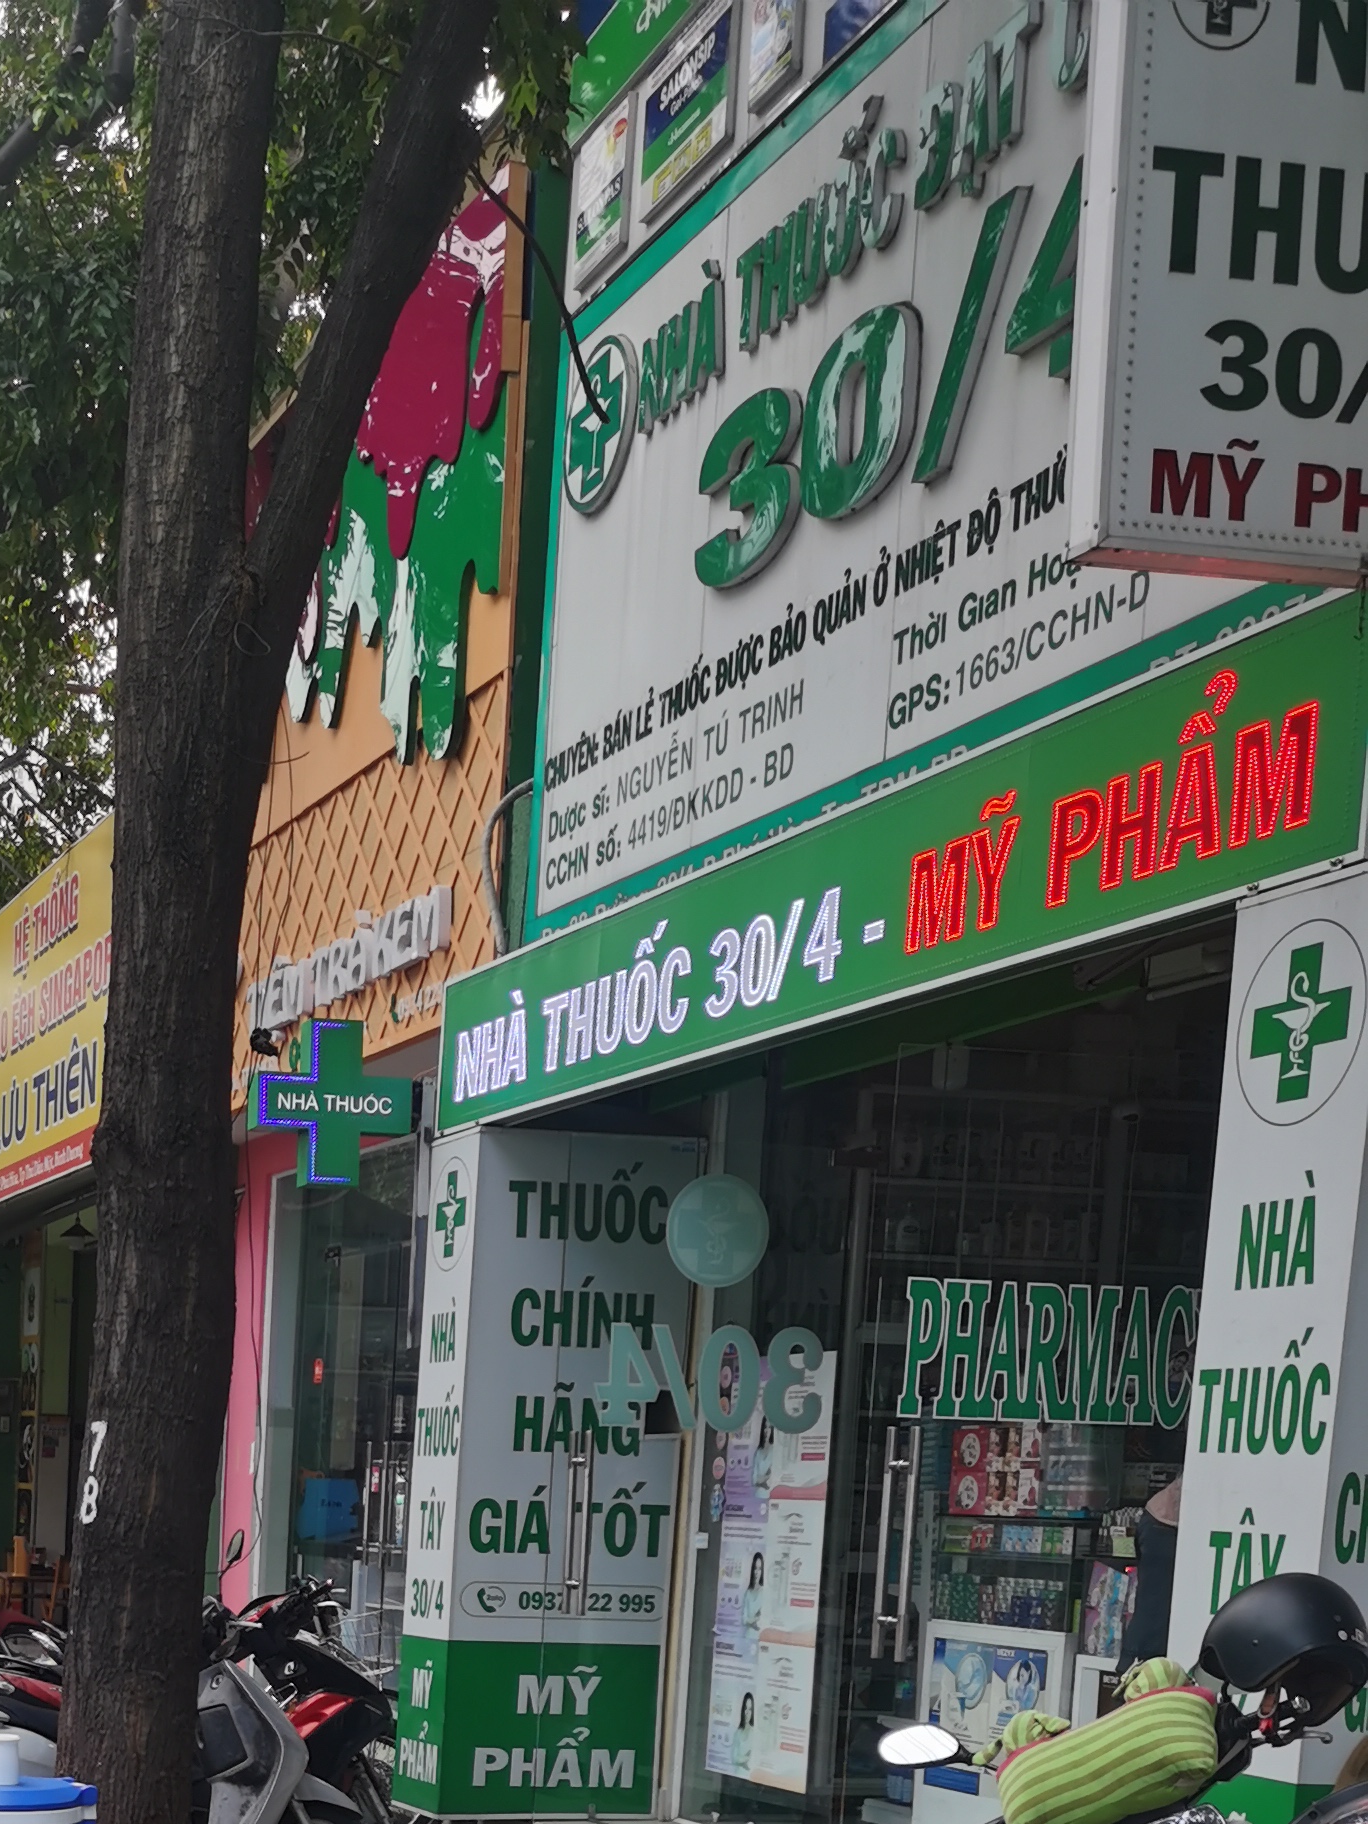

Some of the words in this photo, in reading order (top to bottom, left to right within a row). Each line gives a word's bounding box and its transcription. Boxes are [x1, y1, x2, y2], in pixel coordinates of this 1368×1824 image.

[638, 259, 726, 435] NHÀ
[737, 95, 907, 352] THUỐC
[1150, 438, 1266, 522] MỸ
[602, 709, 633, 761] BÁN
[635, 686, 655, 743] LẺ
[658, 653, 711, 728] THUỐC
[715, 634, 765, 690] ĐƯỢC
[768, 602, 808, 668] BẢO
[812, 568, 868, 646] QUẢN
[872, 546, 892, 607] Ở
[894, 519, 962, 598] NHIỆT
[966, 487, 1001, 557] ĐỘ
[894, 612, 947, 665] Thời
[548, 799, 586, 844] Dược
[616, 729, 694, 808] NGUYỄN
[704, 709, 731, 762] TÚ
[738, 678, 805, 744] TRINH
[546, 843, 589, 890] CCHN
[764, 742, 795, 789] BD
[14, 902, 31, 980] HỆ
[33, 868, 80, 961] THỐNG
[453, 988, 528, 1103] NHÀ
[541, 920, 692, 1073] THUỐC
[704, 886, 844, 1018] 30/4
[904, 788, 1022, 955] MỸ
[1044, 668, 1321, 909] PHẨM
[370, 885, 452, 979] KEM
[11, 984, 37, 1056] ẾCH
[32, 1034, 97, 1135] THIÊN
[277, 1089, 319, 1111] NHÀ
[323, 1091, 393, 1116] THUỐC
[508, 1162, 668, 1246] THUỐC
[1234, 1169, 1316, 1291] NHÀ
[428, 1296, 456, 1364] NHÀ
[510, 1275, 656, 1351] CHÍNH
[896, 1275, 1202, 1431] PHARMAC
[1198, 1326, 1331, 1456] THUỐC
[417, 1384, 460, 1457] THUỐC
[513, 1382, 642, 1457] HÃNG
[420, 1486, 446, 1551] TÂY
[469, 1485, 550, 1555] GIÁ
[575, 1481, 671, 1558] TỐT
[410, 1577, 444, 1620] 30/4
[1209, 1508, 1287, 1614] TÂY
[619, 1593, 656, 1613] 995
[411, 1659, 433, 1710] MỸ
[516, 1665, 602, 1715] MỸ
[398, 1720, 439, 1785] PHẨM
[472, 1727, 636, 1788] PHẨM
